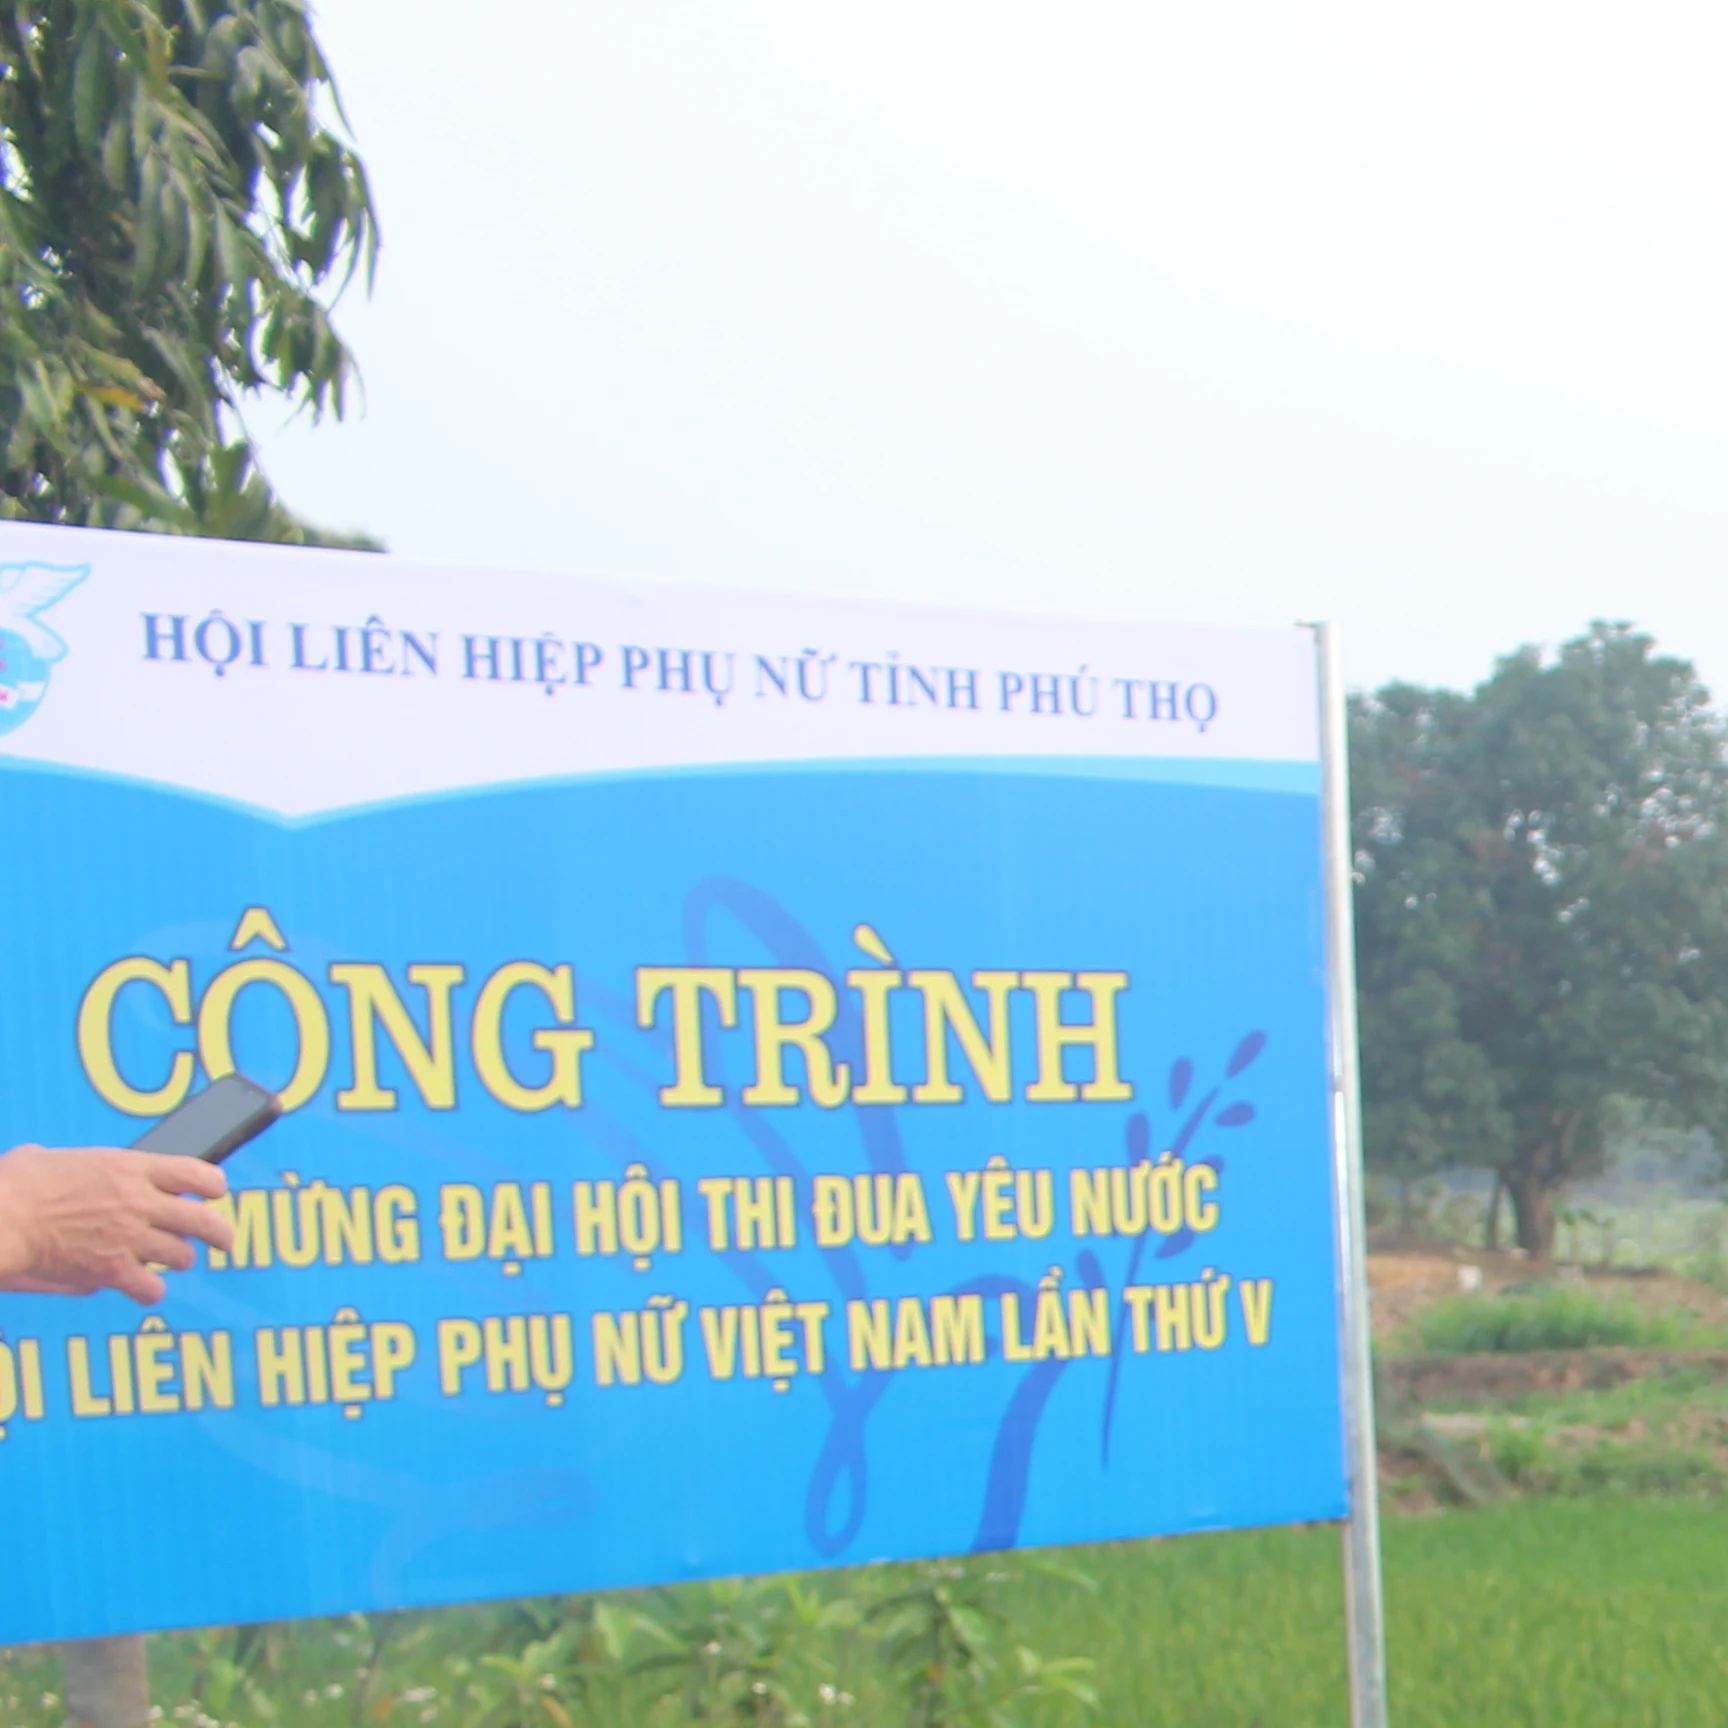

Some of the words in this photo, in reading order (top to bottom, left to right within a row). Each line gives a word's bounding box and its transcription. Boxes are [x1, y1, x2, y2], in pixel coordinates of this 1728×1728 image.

[140, 609, 268, 678] HỘI
[287, 616, 440, 676] LIÊN
[460, 632, 604, 696] HIỆP
[619, 644, 735, 708] PHỤ
[752, 647, 837, 701] NỮ
[847, 649, 982, 710] TỈNH
[996, 664, 1099, 718] PHÚ
[1111, 678, 1218, 733] THỌ
[77, 905, 594, 1116] CÔNG
[635, 922, 1134, 1109] TRÌNH
[207, 1170, 421, 1270] MỪNG
[440, 1182, 554, 1276] ĐẠI
[572, 1162, 682, 1272] HỘI
[698, 1175, 796, 1251] THI
[812, 1173, 932, 1248] ĐUA
[945, 1155, 1054, 1241] YÊU
[1069, 1150, 1219, 1237] NƯỚC
[67, 1314, 235, 1418] LIÊN
[255, 1306, 416, 1421] HIỆP
[437, 1313, 573, 1407] PHỤ
[592, 1293, 689, 1387] NỮ
[700, 1288, 829, 1393] VIỆT
[846, 1294, 986, 1371] NAM
[1000, 1264, 1112, 1361] LẦN
[1124, 1267, 1231, 1354] THỨ
[1239, 1278, 1273, 1346] V
